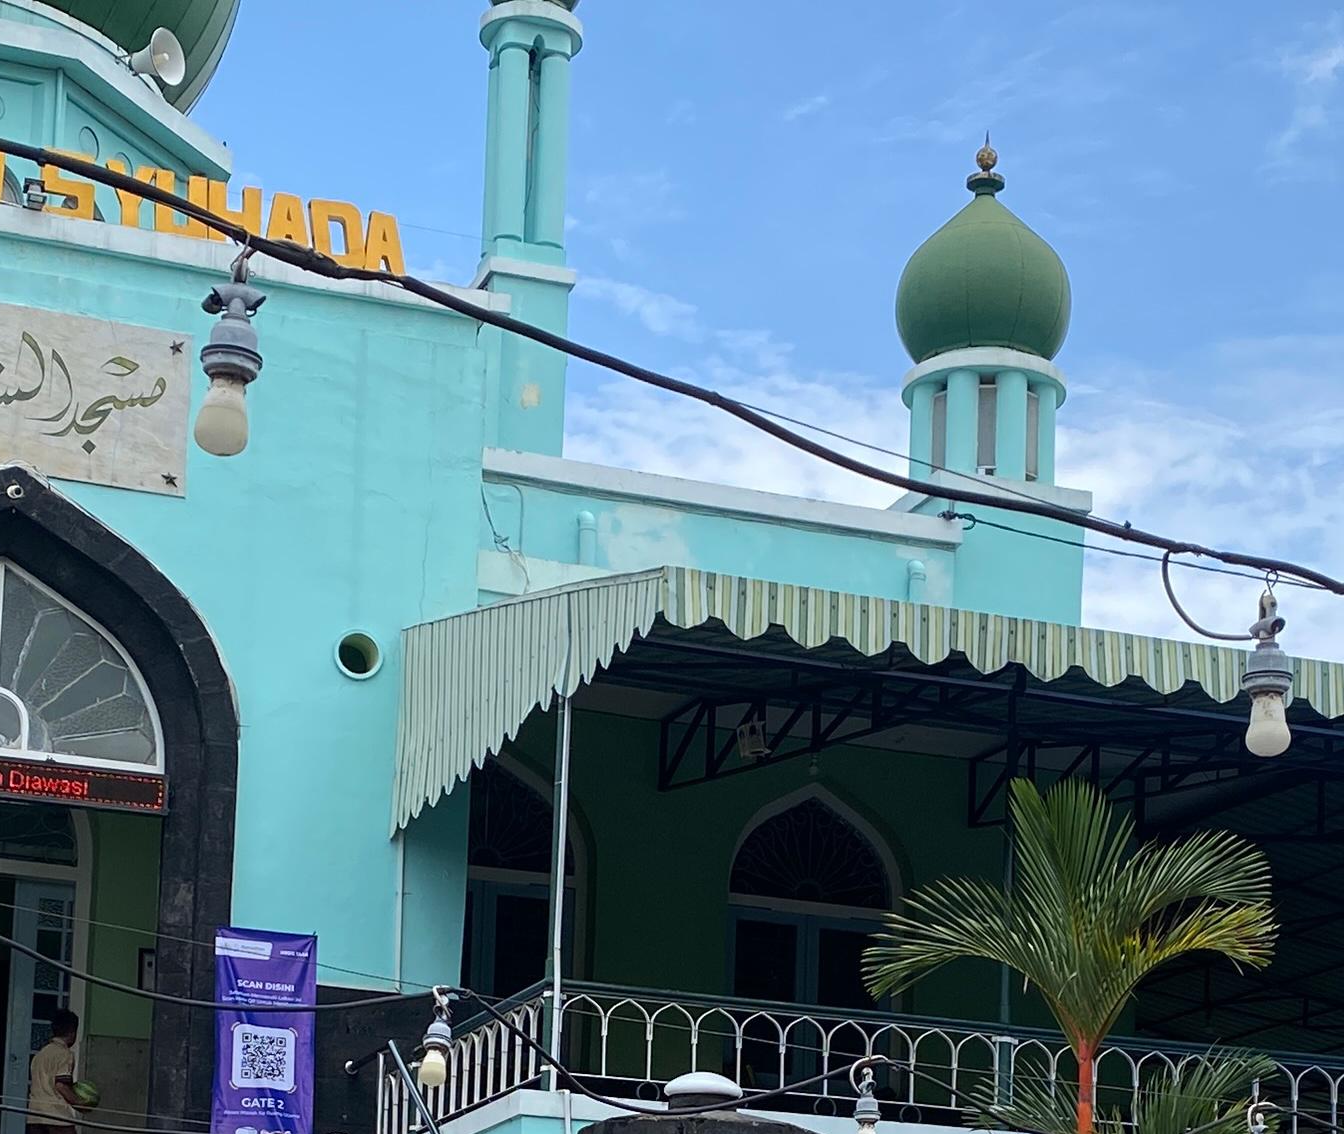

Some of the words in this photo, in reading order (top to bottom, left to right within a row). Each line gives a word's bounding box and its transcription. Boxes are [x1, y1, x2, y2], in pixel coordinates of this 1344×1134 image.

[40, 146, 405, 278] SYUHADA
[9, 769, 88, 795] Diawasi
[237, 979, 263, 989] SCAN
[265, 982, 295, 992] DISINI
[241, 1098, 275, 1108] GATE
[277, 1100, 285, 1109] 2
